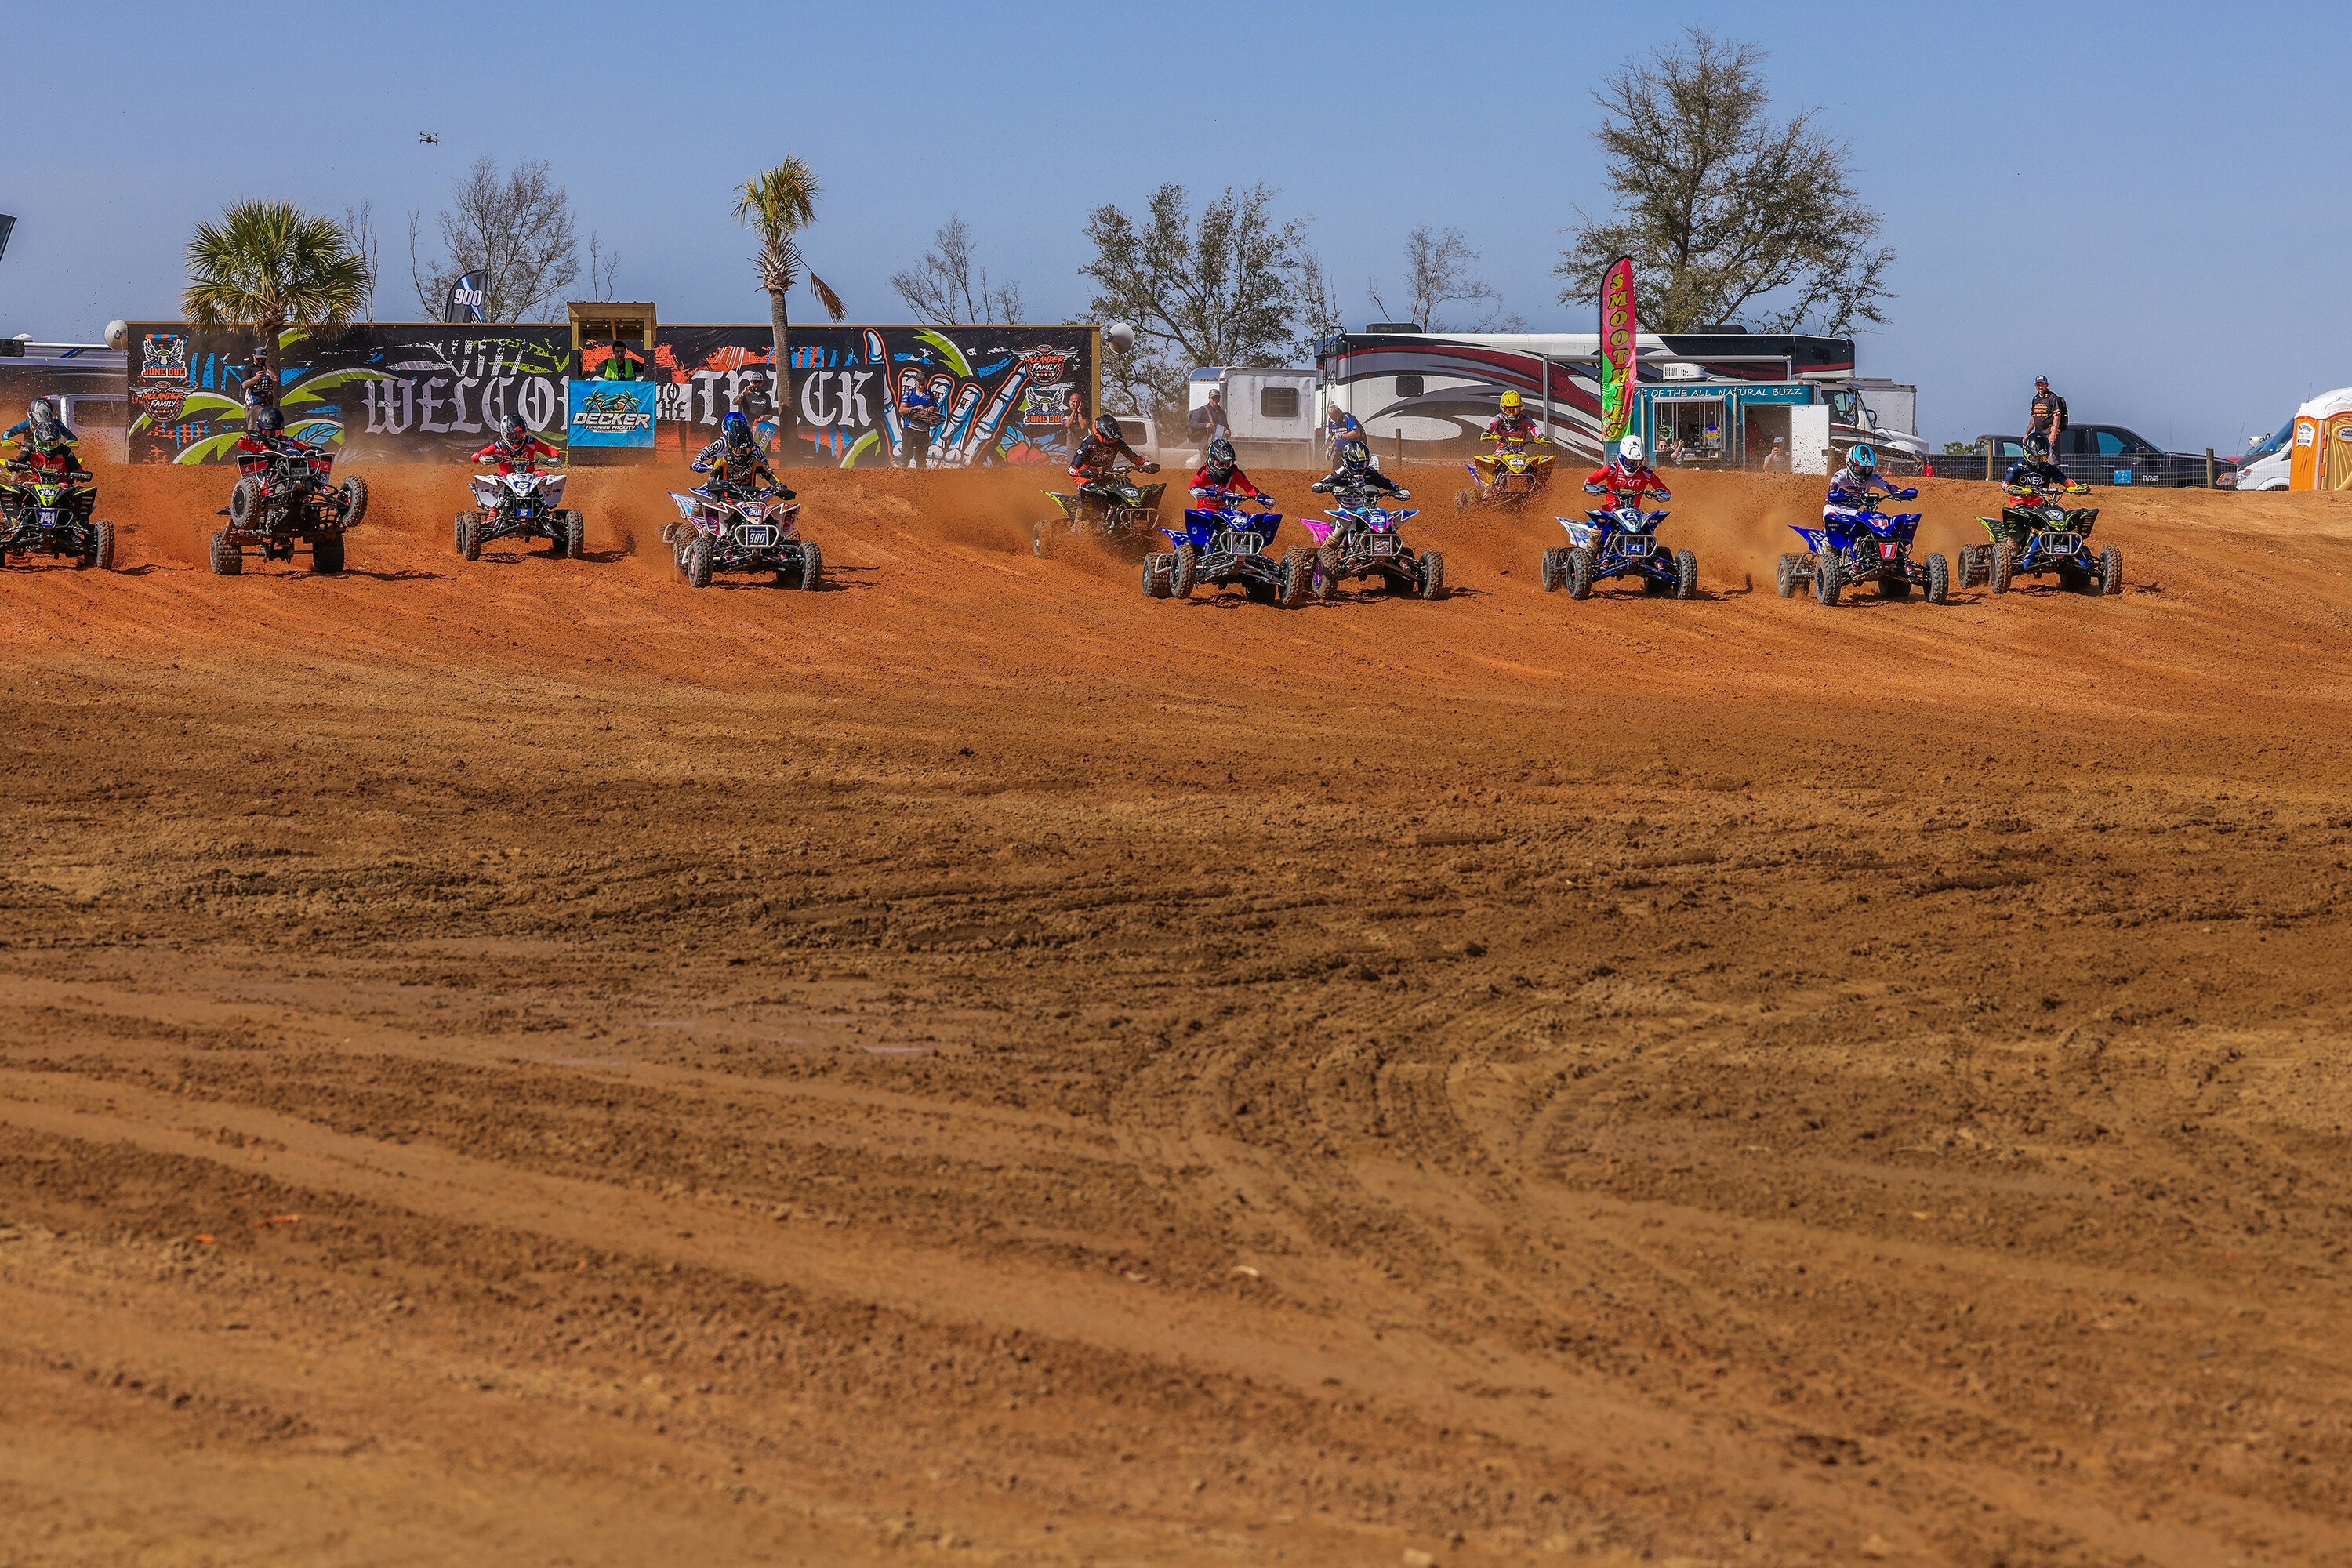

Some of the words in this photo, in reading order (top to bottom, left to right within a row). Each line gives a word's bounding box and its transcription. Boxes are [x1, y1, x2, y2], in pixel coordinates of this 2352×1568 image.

[453, 288, 483, 307] 900
[1024, 354, 1065, 364] MOLANDER
[1606, 272, 1631, 439] SMOOTHIES
[1032, 363, 1058, 372] FAMILY
[142, 392, 185, 401] MOLANDER
[1650, 389, 1664, 397] OF
[1718, 387, 1769, 396] NATURAL
[361, 376, 570, 435] WELCO
[572, 412, 651, 429] DECKER
[1615, 477, 1642, 487] FXR
[39, 511, 55, 524] 741
[1625, 512, 1639, 521] 4
[749, 532, 766, 543] 900
[1884, 544, 1893, 558] 1
